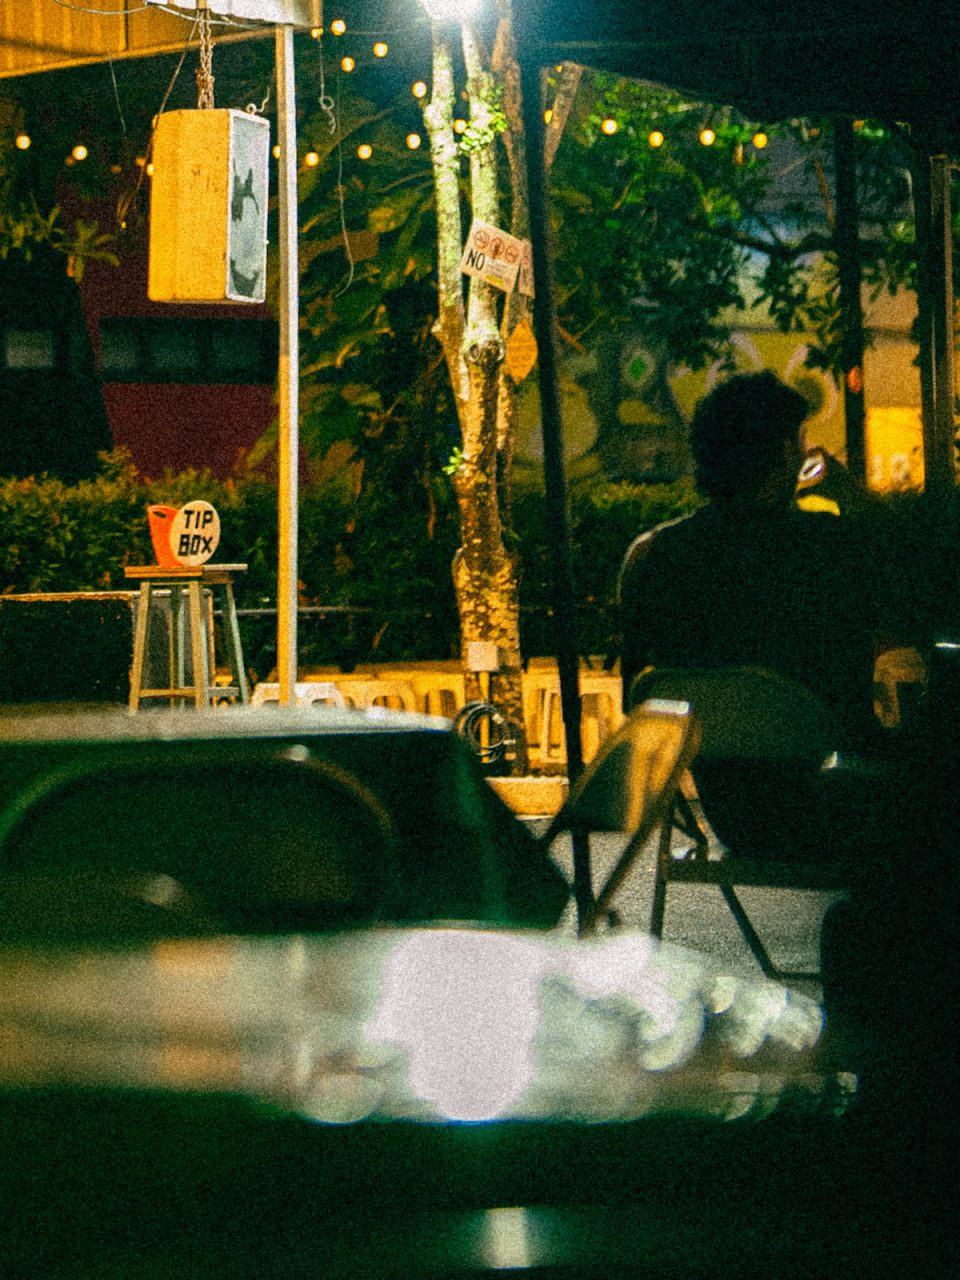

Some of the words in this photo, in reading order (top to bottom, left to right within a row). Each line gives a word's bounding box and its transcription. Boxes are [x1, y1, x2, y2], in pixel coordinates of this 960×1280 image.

[465, 248, 486, 271] NO
[184, 509, 214, 529] TIP
[178, 533, 214, 557] BOX
